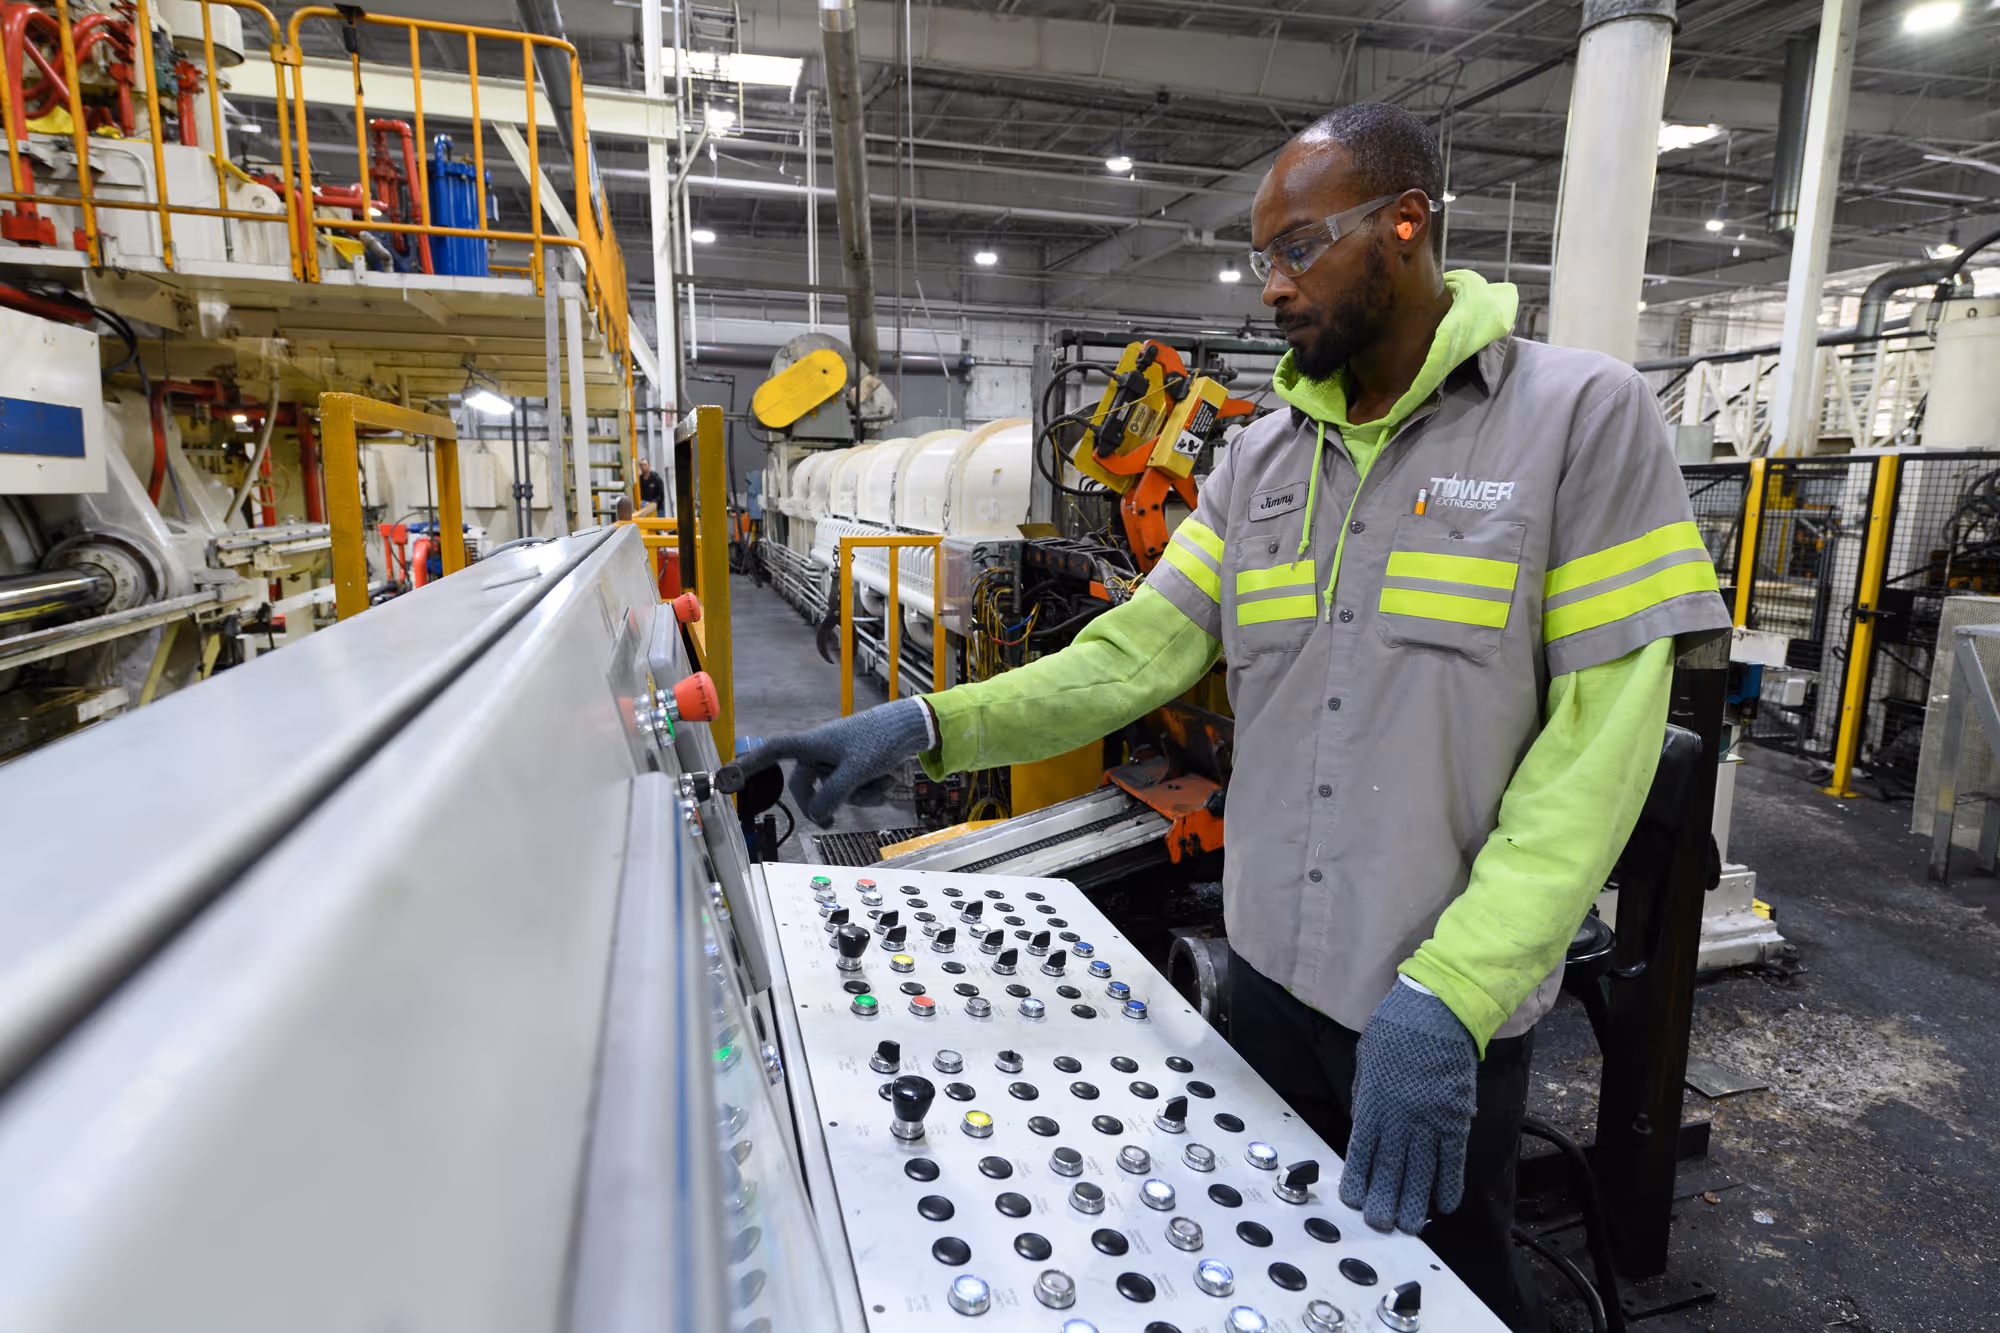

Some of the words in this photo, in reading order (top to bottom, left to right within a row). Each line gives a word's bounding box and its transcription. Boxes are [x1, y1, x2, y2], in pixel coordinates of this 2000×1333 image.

[1430, 474, 1515, 501] TOWER
[1261, 494, 1294, 510] Jimmy
[1435, 497, 1497, 510] EXTRUSIONS
